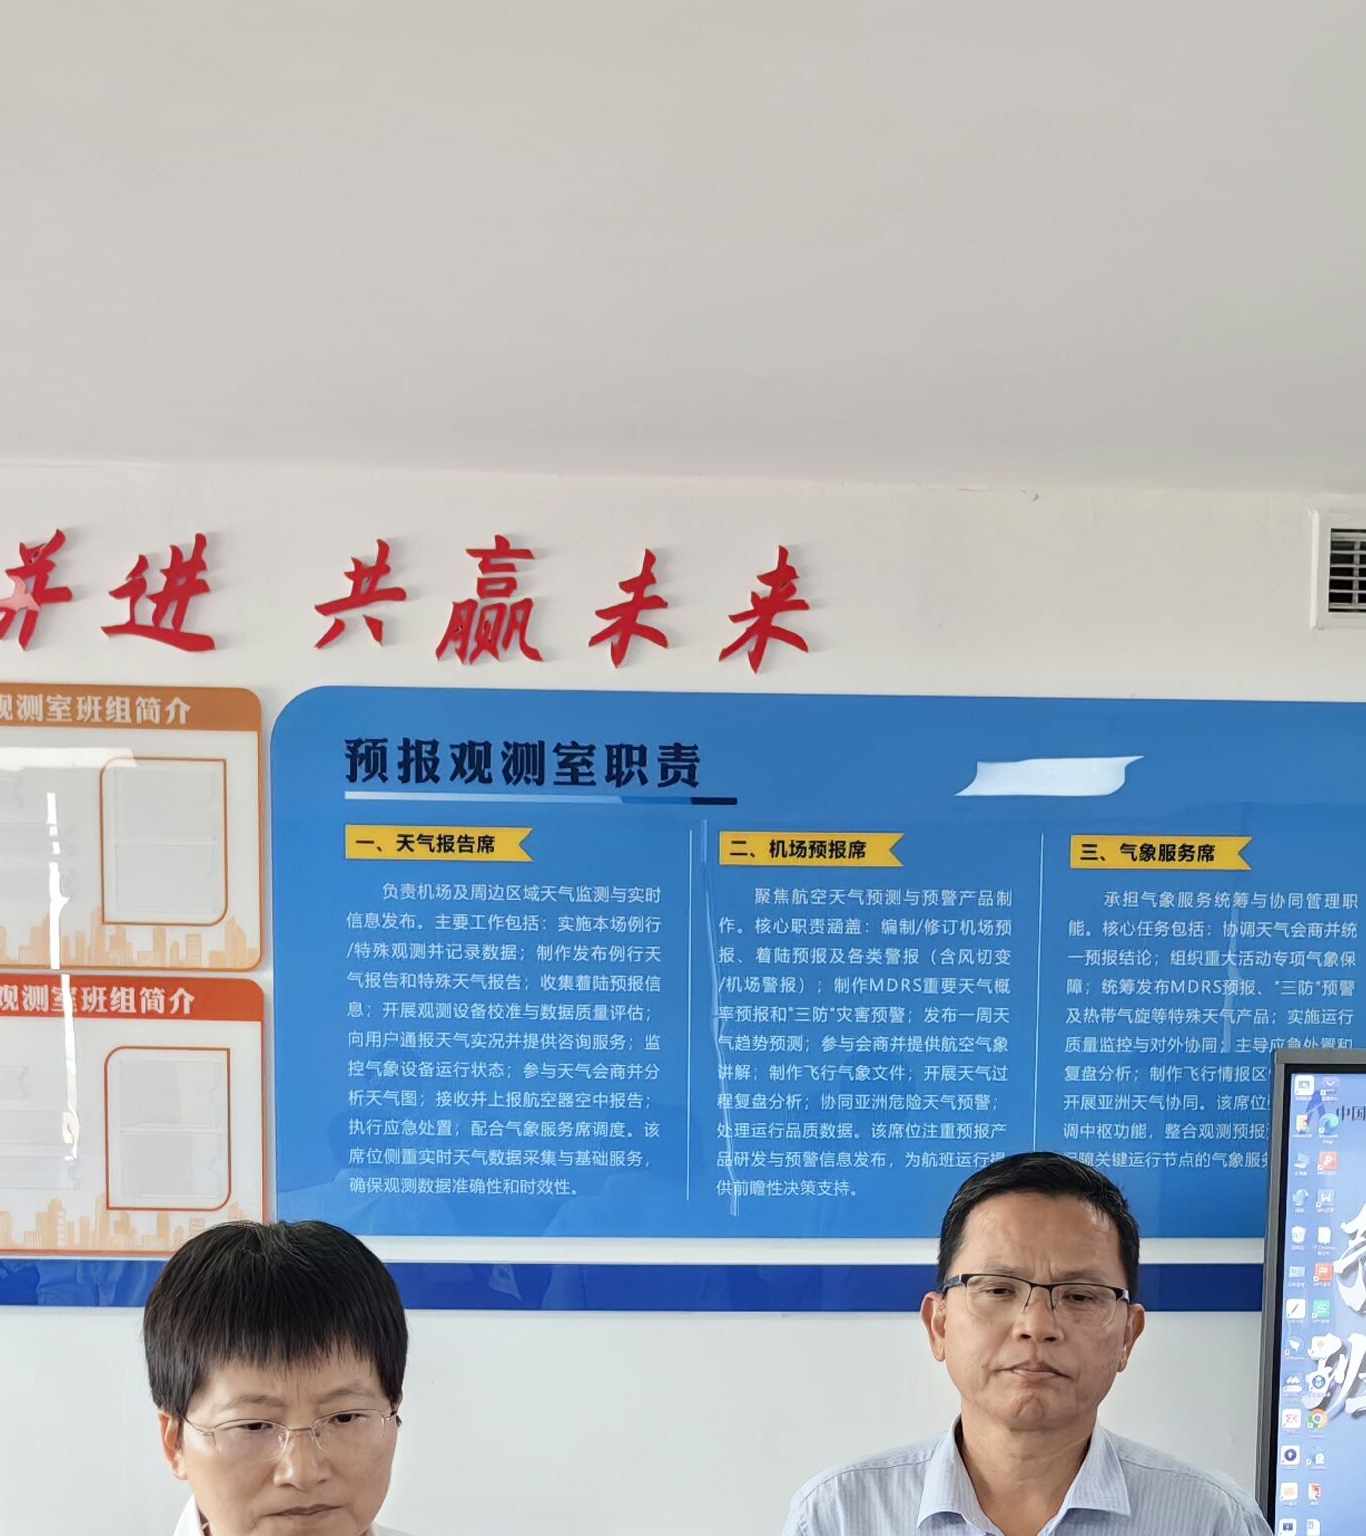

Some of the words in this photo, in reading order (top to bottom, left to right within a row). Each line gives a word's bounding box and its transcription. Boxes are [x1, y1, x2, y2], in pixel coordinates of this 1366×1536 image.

[314, 535, 811, 674] 共赢未来
[345, 737, 701, 788] 预报观测室职责
[356, 834, 496, 854] 一、天气报告席
[730, 839, 867, 860] 二、机场预报席
[1080, 843, 1216, 863] 三、气象服务席
[382, 883, 661, 904] 负责机场及周边区域天气监测与实时
[754, 888, 1013, 907] 聚焦航空天气预测与预警产品制
[1104, 891, 1358, 910] 承担气象服务统筹与协同管理职
[346, 912, 662, 933] 信息发布。主要工作包括：实施本场例行
[718, 917, 1013, 937] 作。核心职责涵盖：编制/修订机场预
[1068, 920, 1358, 939] 能。核心任务包括：协调天气会商并统
[346, 942, 662, 962] /特殊观测并记录数据；制作发布例行天
[1068, 949, 1356, 968] 一预报结论；组织重大活动专项气象保
[347, 972, 661, 992] 气报告和特殊天气报告；收集着陆预报信
[347, 1001, 652, 1022] 息；开展观测设备校准与数据质量评估；
[1066, 1007, 1354, 1026] 及热带气旋等特殊天气产品；实施运行
[348, 1031, 661, 1051] 向用户通报天气实况并提供咨询服务；监
[718, 1034, 1009, 1052] 气趋势预测；参与会商并提供航空气象
[348, 1061, 660, 1080] 控气象设备运行状态；参与天气会商并分
[717, 1064, 1009, 1083] 讲解；制作飞行气象文件；开展天气过
[1064, 1066, 1271, 1082] 复盘分析；制作飞行情报区
[348, 1090, 652, 1109] 析天气图；接收并上报航空器空中报告；
[717, 1093, 998, 1111] 程复盘分析；协同亚洲危险天气预警；
[1063, 1094, 1271, 1111] 开展亚洲天气协同。该席位
[348, 1119, 660, 1138] 执行应急处置；配合气象服务席调度。该
[717, 1123, 1007, 1140] 处理运行品质数据。该席位注重预报产
[1063, 1123, 1270, 1140] 调中枢功能，整合观测预报
[348, 1148, 652, 1168] 席位侧重实时天气数据采集与基础服务，
[349, 1177, 578, 1196] 确保观测数据准确性和时效性。
[716, 1179, 857, 1197] 供前瞻性决策支持。
